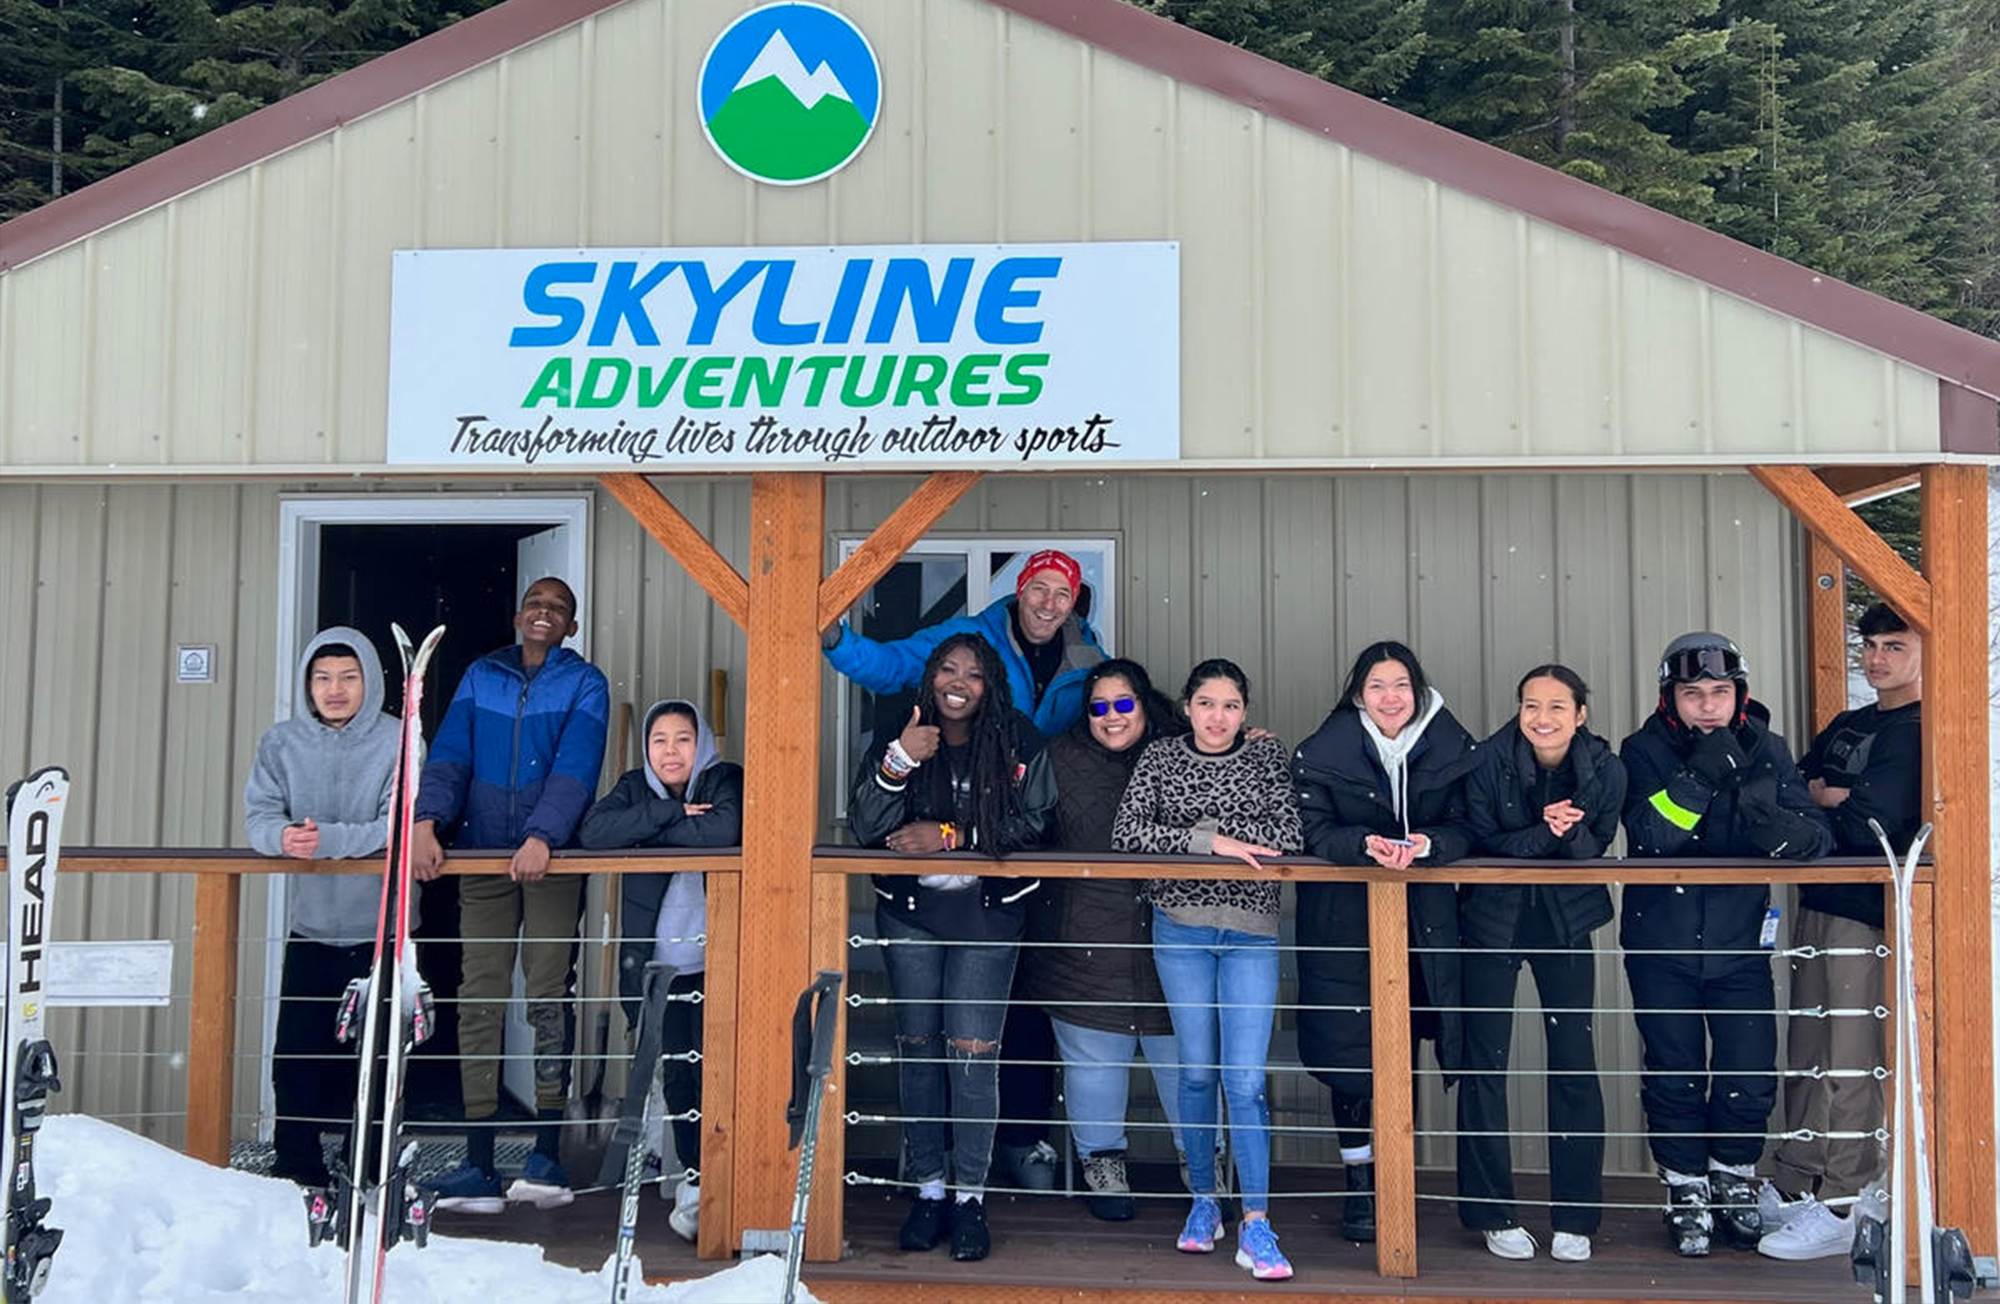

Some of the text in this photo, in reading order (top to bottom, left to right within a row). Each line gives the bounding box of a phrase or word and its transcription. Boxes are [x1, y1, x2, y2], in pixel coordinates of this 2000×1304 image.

[509, 257, 1063, 348] SKYLINE
[522, 354, 1050, 408] ADVENTURES
[450, 413, 1121, 462] Transforming lives through outdoor sports
[20, 810, 49, 993] HEAD
